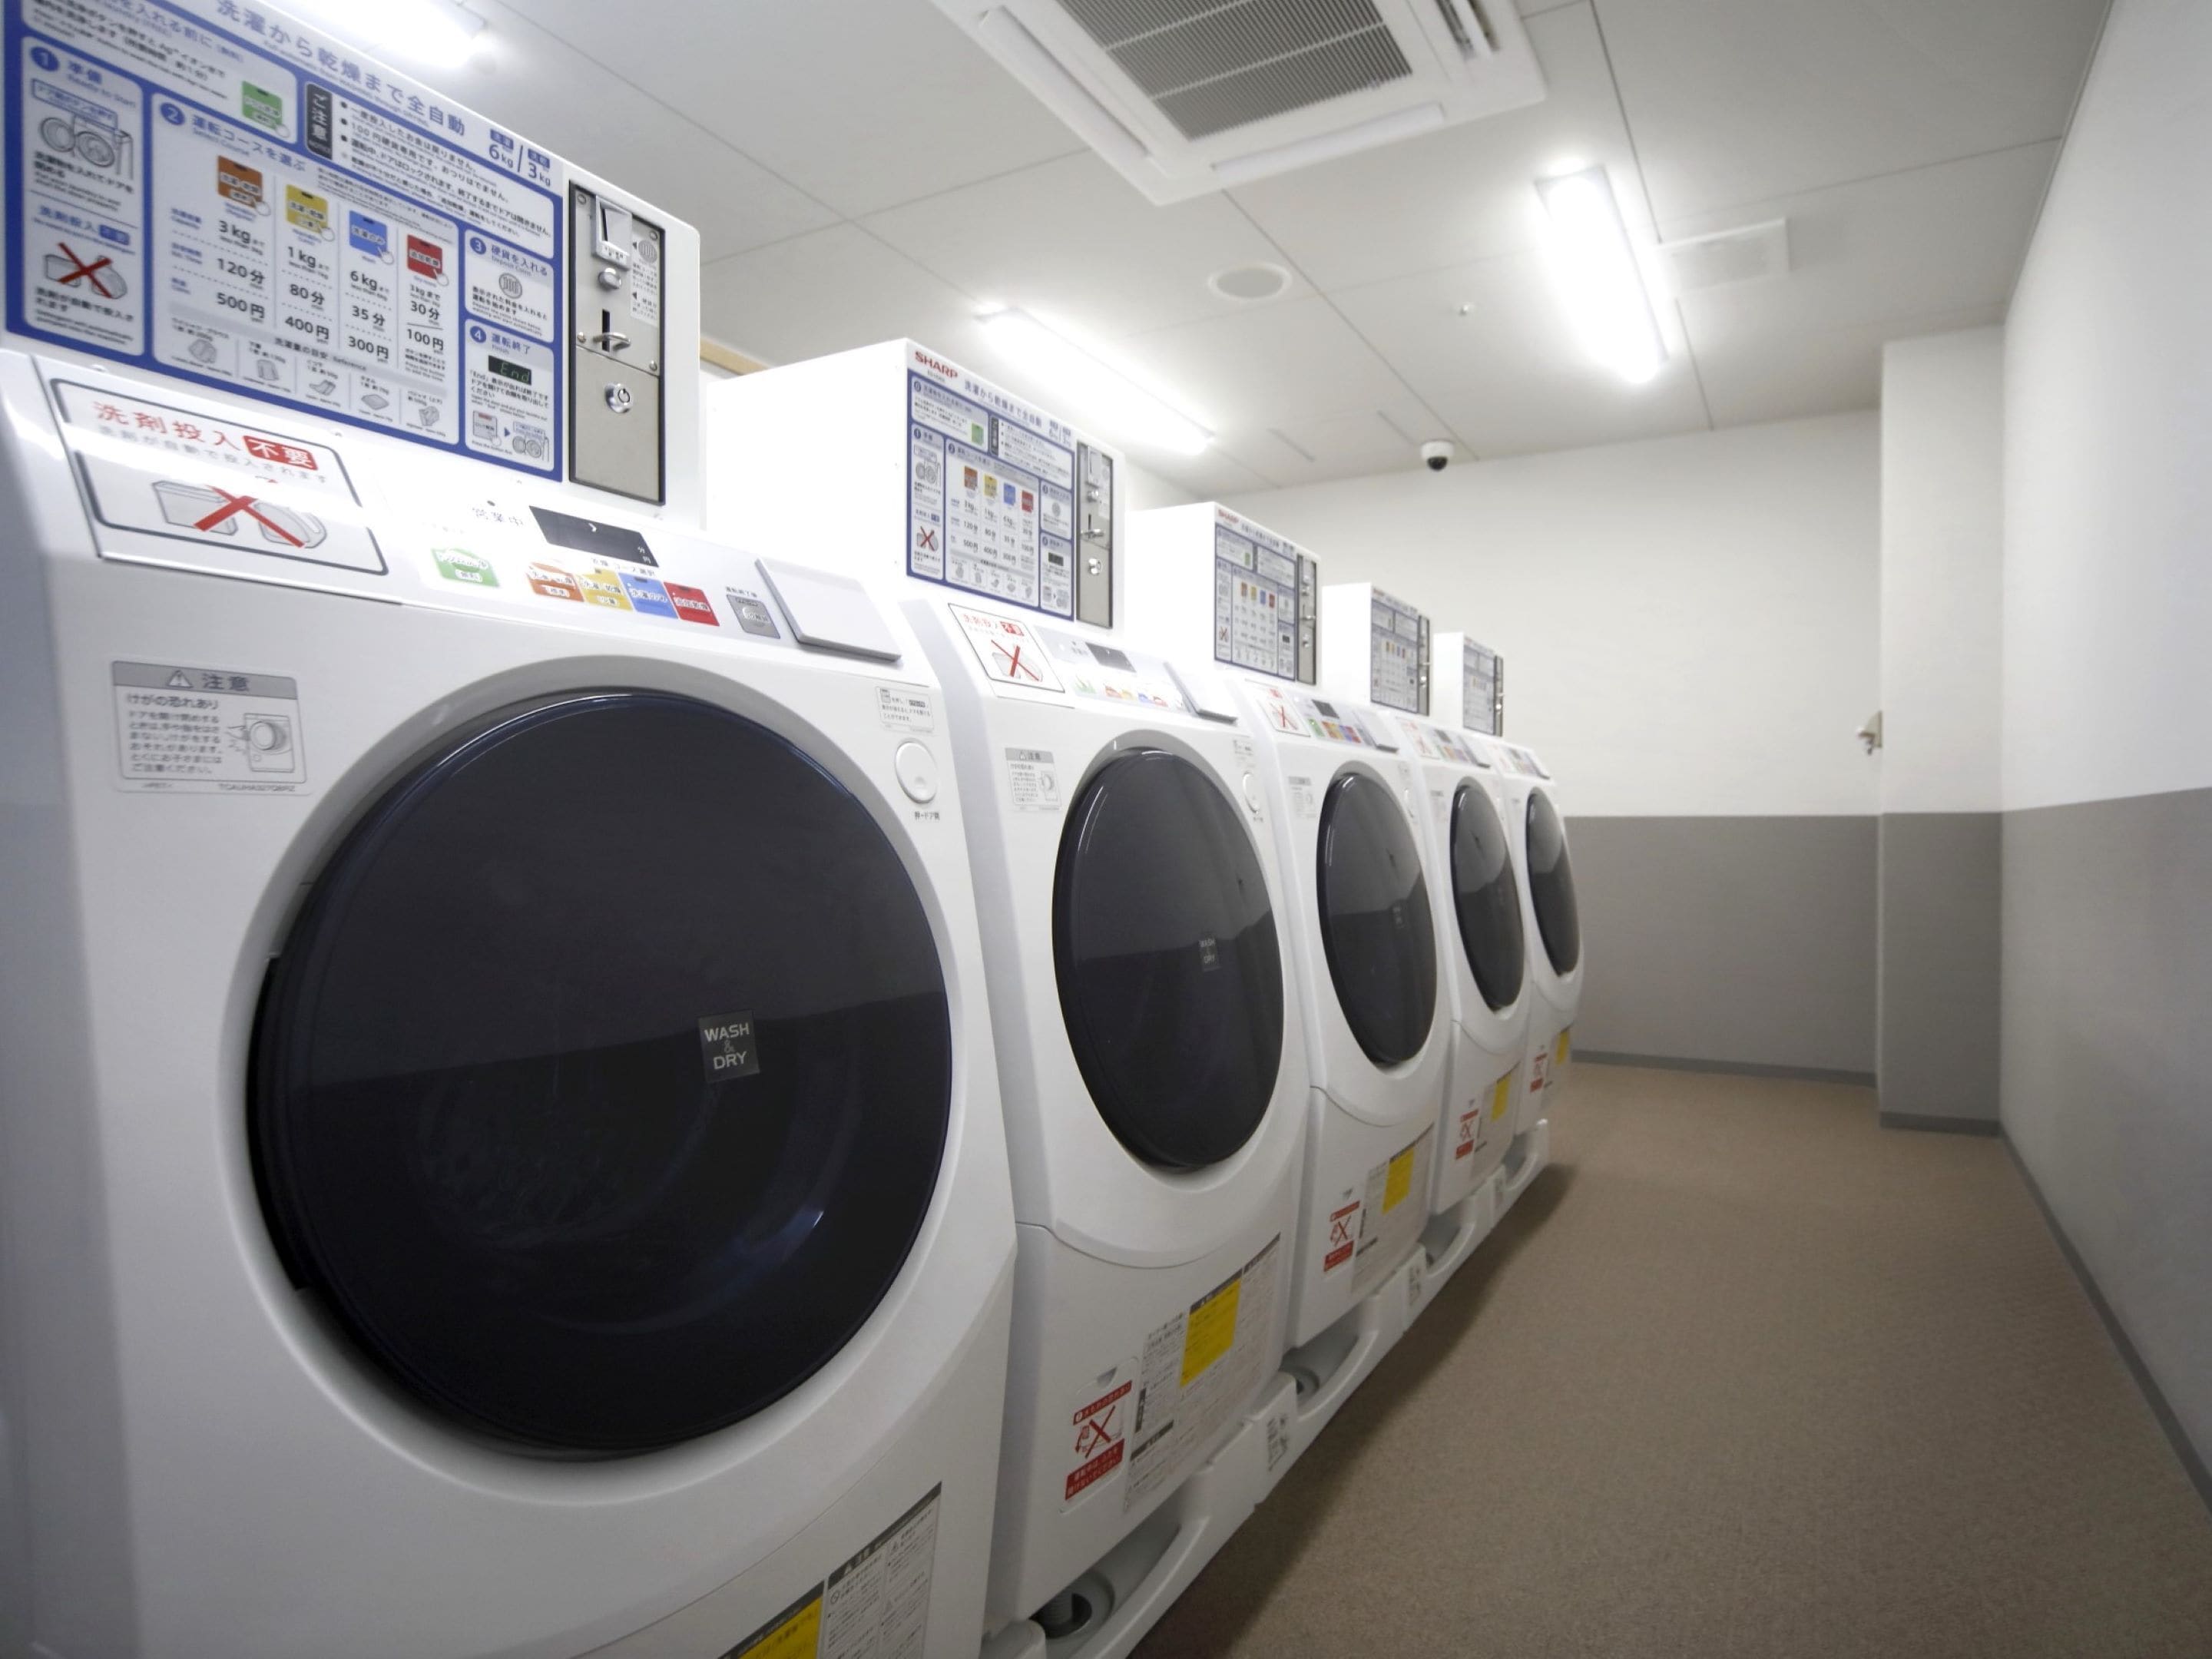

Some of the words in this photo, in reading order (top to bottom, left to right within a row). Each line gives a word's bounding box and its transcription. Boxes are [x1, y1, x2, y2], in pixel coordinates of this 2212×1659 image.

[217, 0, 465, 137] 洗濯から乾燥まで全自動
[492, 333, 531, 355] 運転終了
[915, 350, 959, 379] SHARP
[91, 401, 241, 452] 洗剤投入
[250, 438, 315, 469] 不要
[202, 672, 250, 692] 注意
[704, 1022, 750, 1042] WASH
[724, 1039, 735, 1053] &
[713, 1051, 748, 1070] DRY
